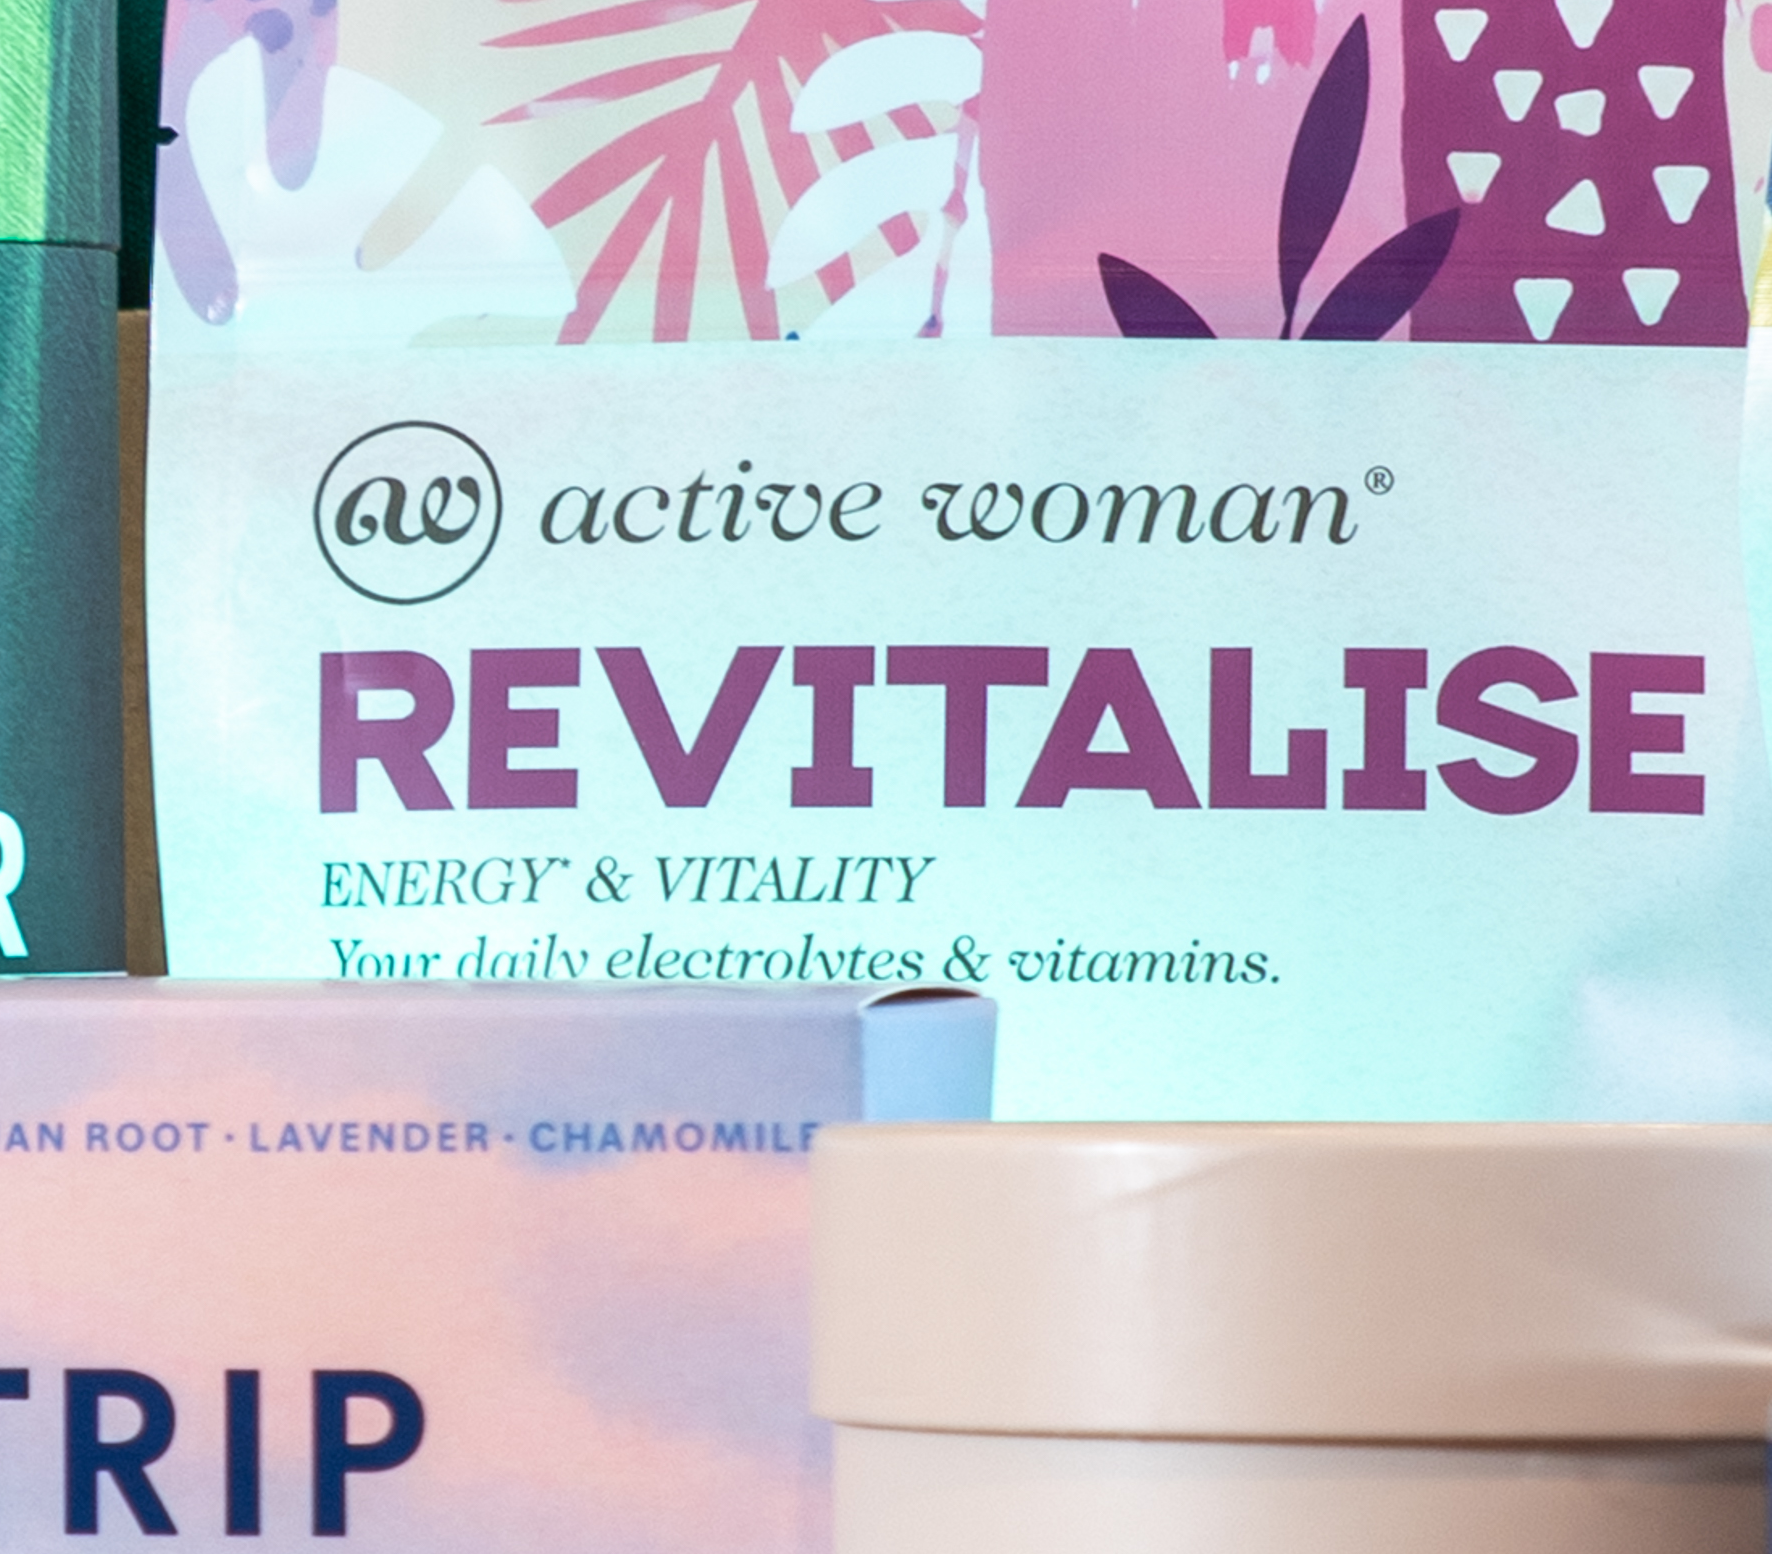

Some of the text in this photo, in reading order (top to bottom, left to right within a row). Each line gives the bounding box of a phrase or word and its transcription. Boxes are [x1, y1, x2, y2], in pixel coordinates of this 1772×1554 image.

[540, 459, 883, 545] active
[317, 644, 1707, 816] REVITALISE
[585, 855, 937, 905] & VITALITY
[330, 933, 1282, 984] Your daily & vitamins.
[85, 1122, 210, 1153] ROOT
[250, 1122, 490, 1153] LAVENDER
